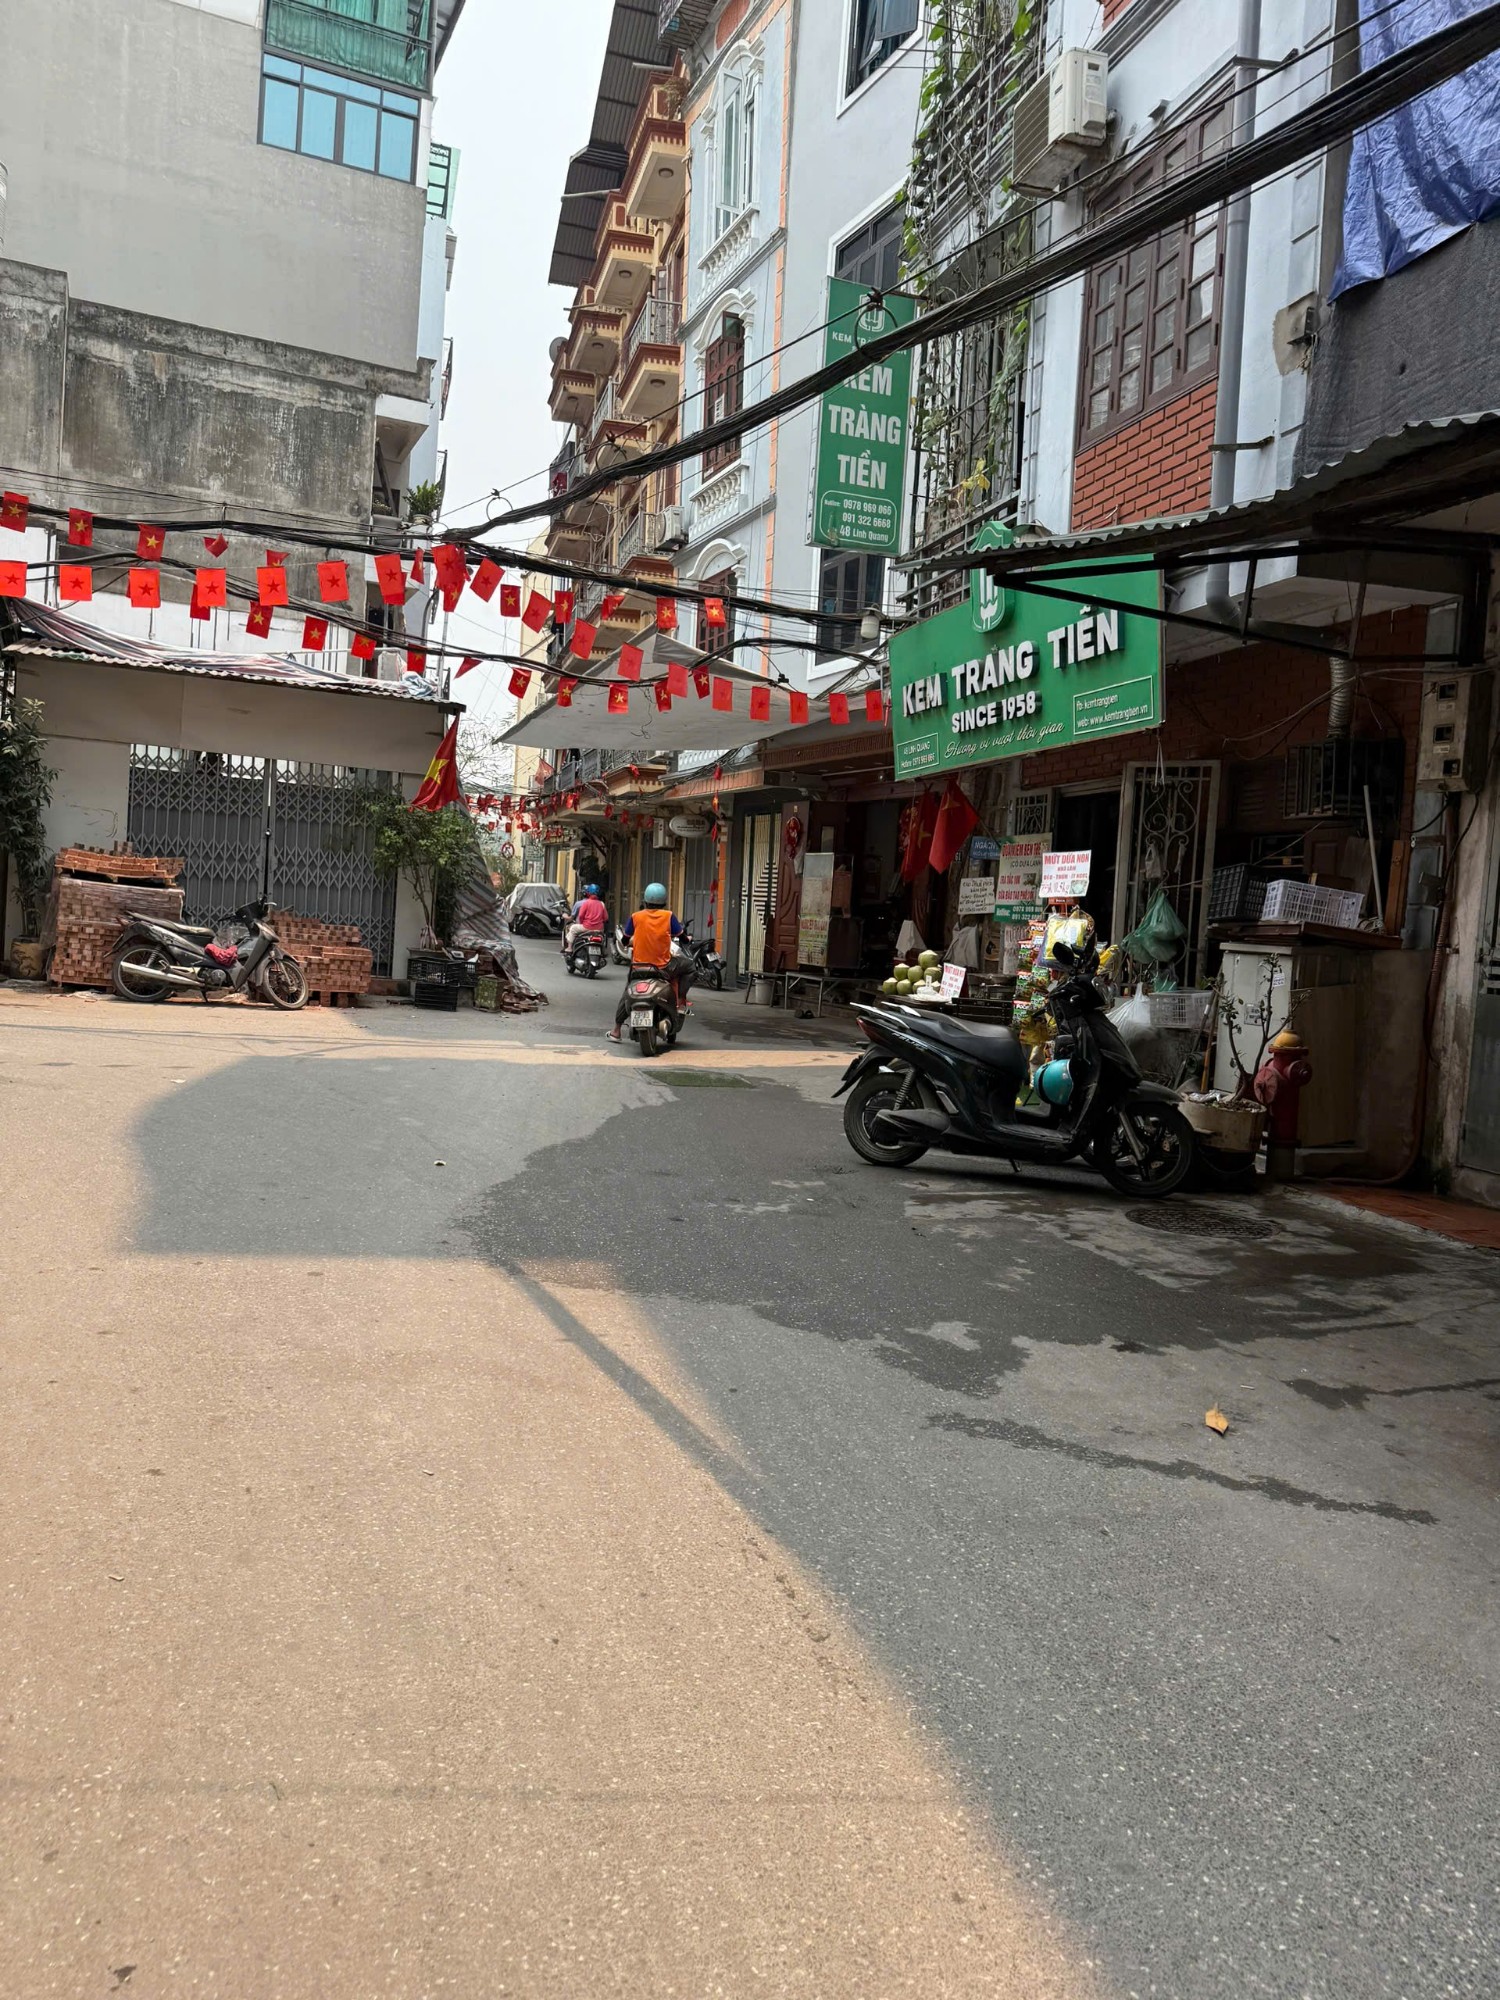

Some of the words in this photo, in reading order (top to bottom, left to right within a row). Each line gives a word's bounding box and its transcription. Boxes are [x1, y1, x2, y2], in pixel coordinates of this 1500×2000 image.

[832, 331, 852, 343] KEM
[828, 403, 902, 445] TRÀNG
[837, 449, 887, 490] TIỀN
[842, 512, 856, 523] 091
[857, 515, 872, 526] 322
[873, 518, 891, 528] 6668
[843, 499, 862, 511] 0978
[863, 502, 877, 513] 969
[878, 505, 892, 515] 066
[840, 525, 851, 537] 48
[853, 528, 867, 539] Linh
[868, 531, 889, 542] Quang
[902, 673, 943, 717] KEM
[951, 701, 997, 734] SINCE
[1001, 690, 1037, 721] 1958
